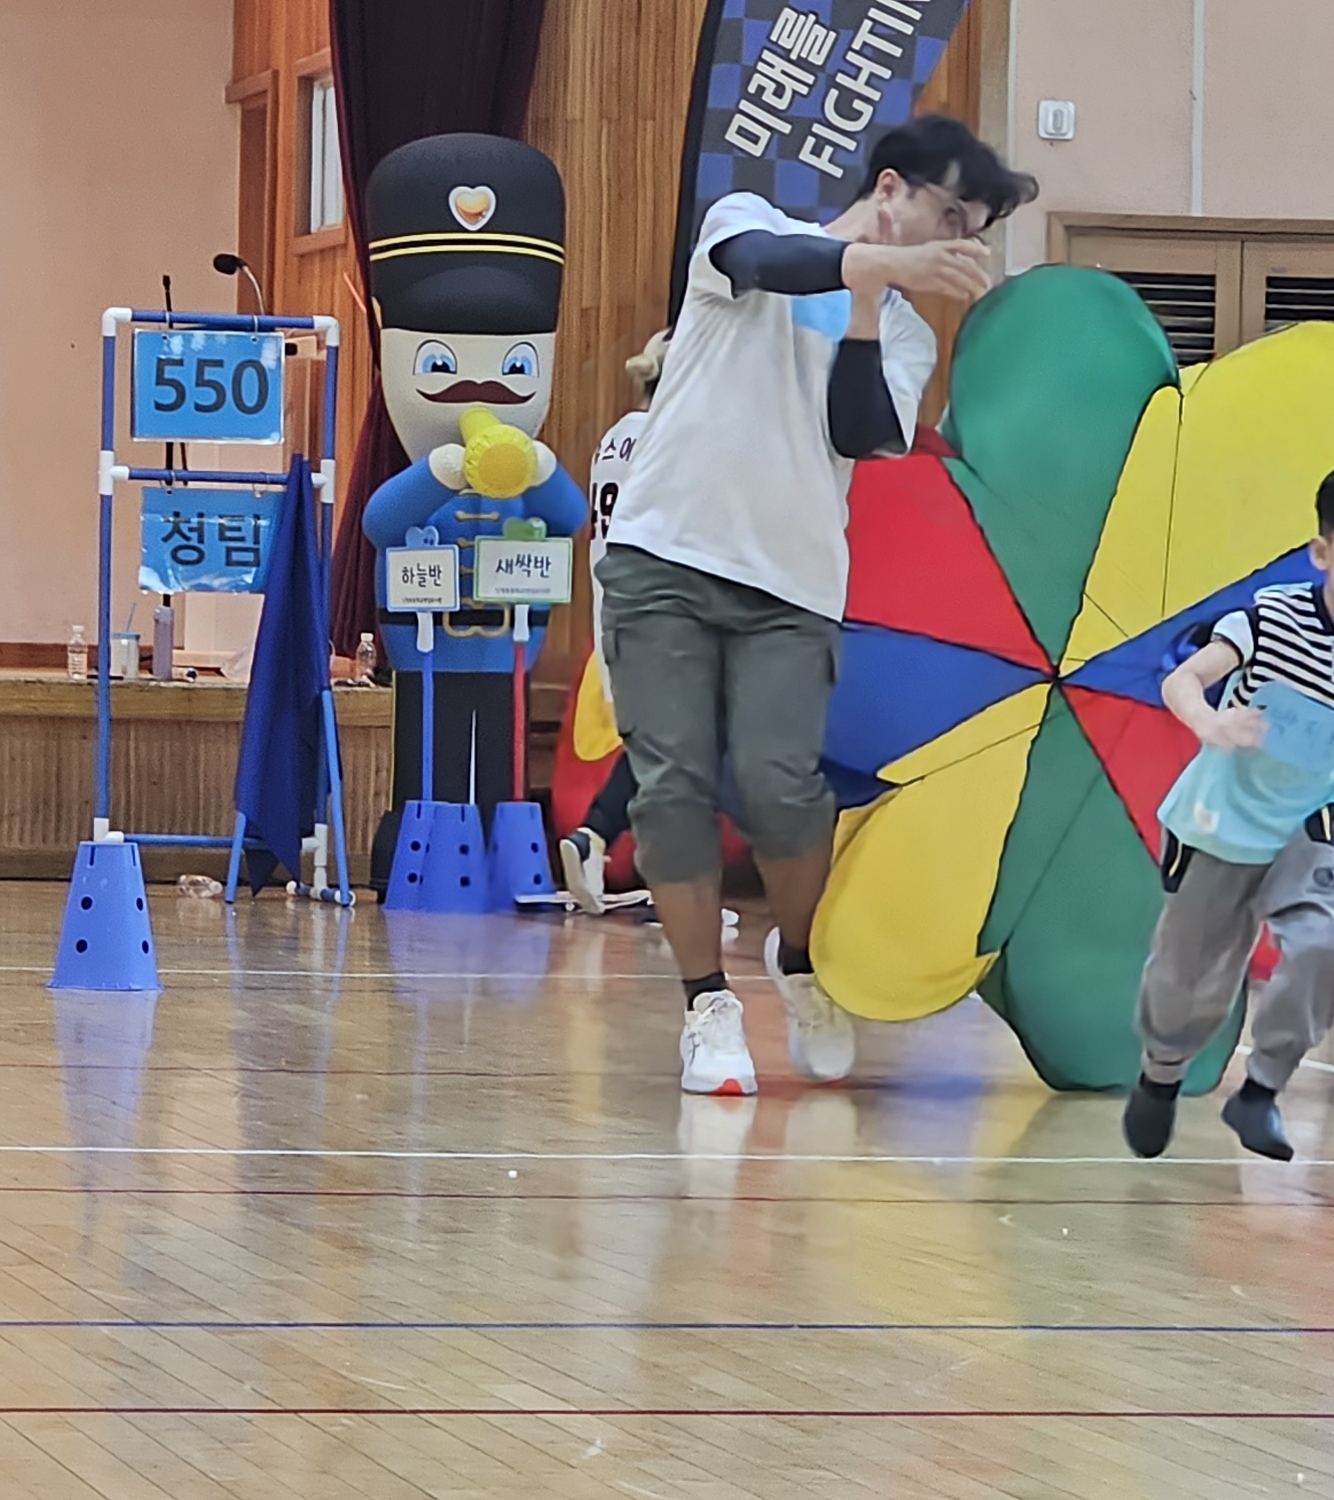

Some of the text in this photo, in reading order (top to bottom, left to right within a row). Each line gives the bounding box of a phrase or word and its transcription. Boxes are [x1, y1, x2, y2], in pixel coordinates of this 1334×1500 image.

[724, 6, 837, 158] 미래를
[153, 358, 269, 415] 550
[161, 510, 261, 567] 청팀
[495, 553, 552, 579] 새싹반
[401, 563, 443, 588] 하늘반
